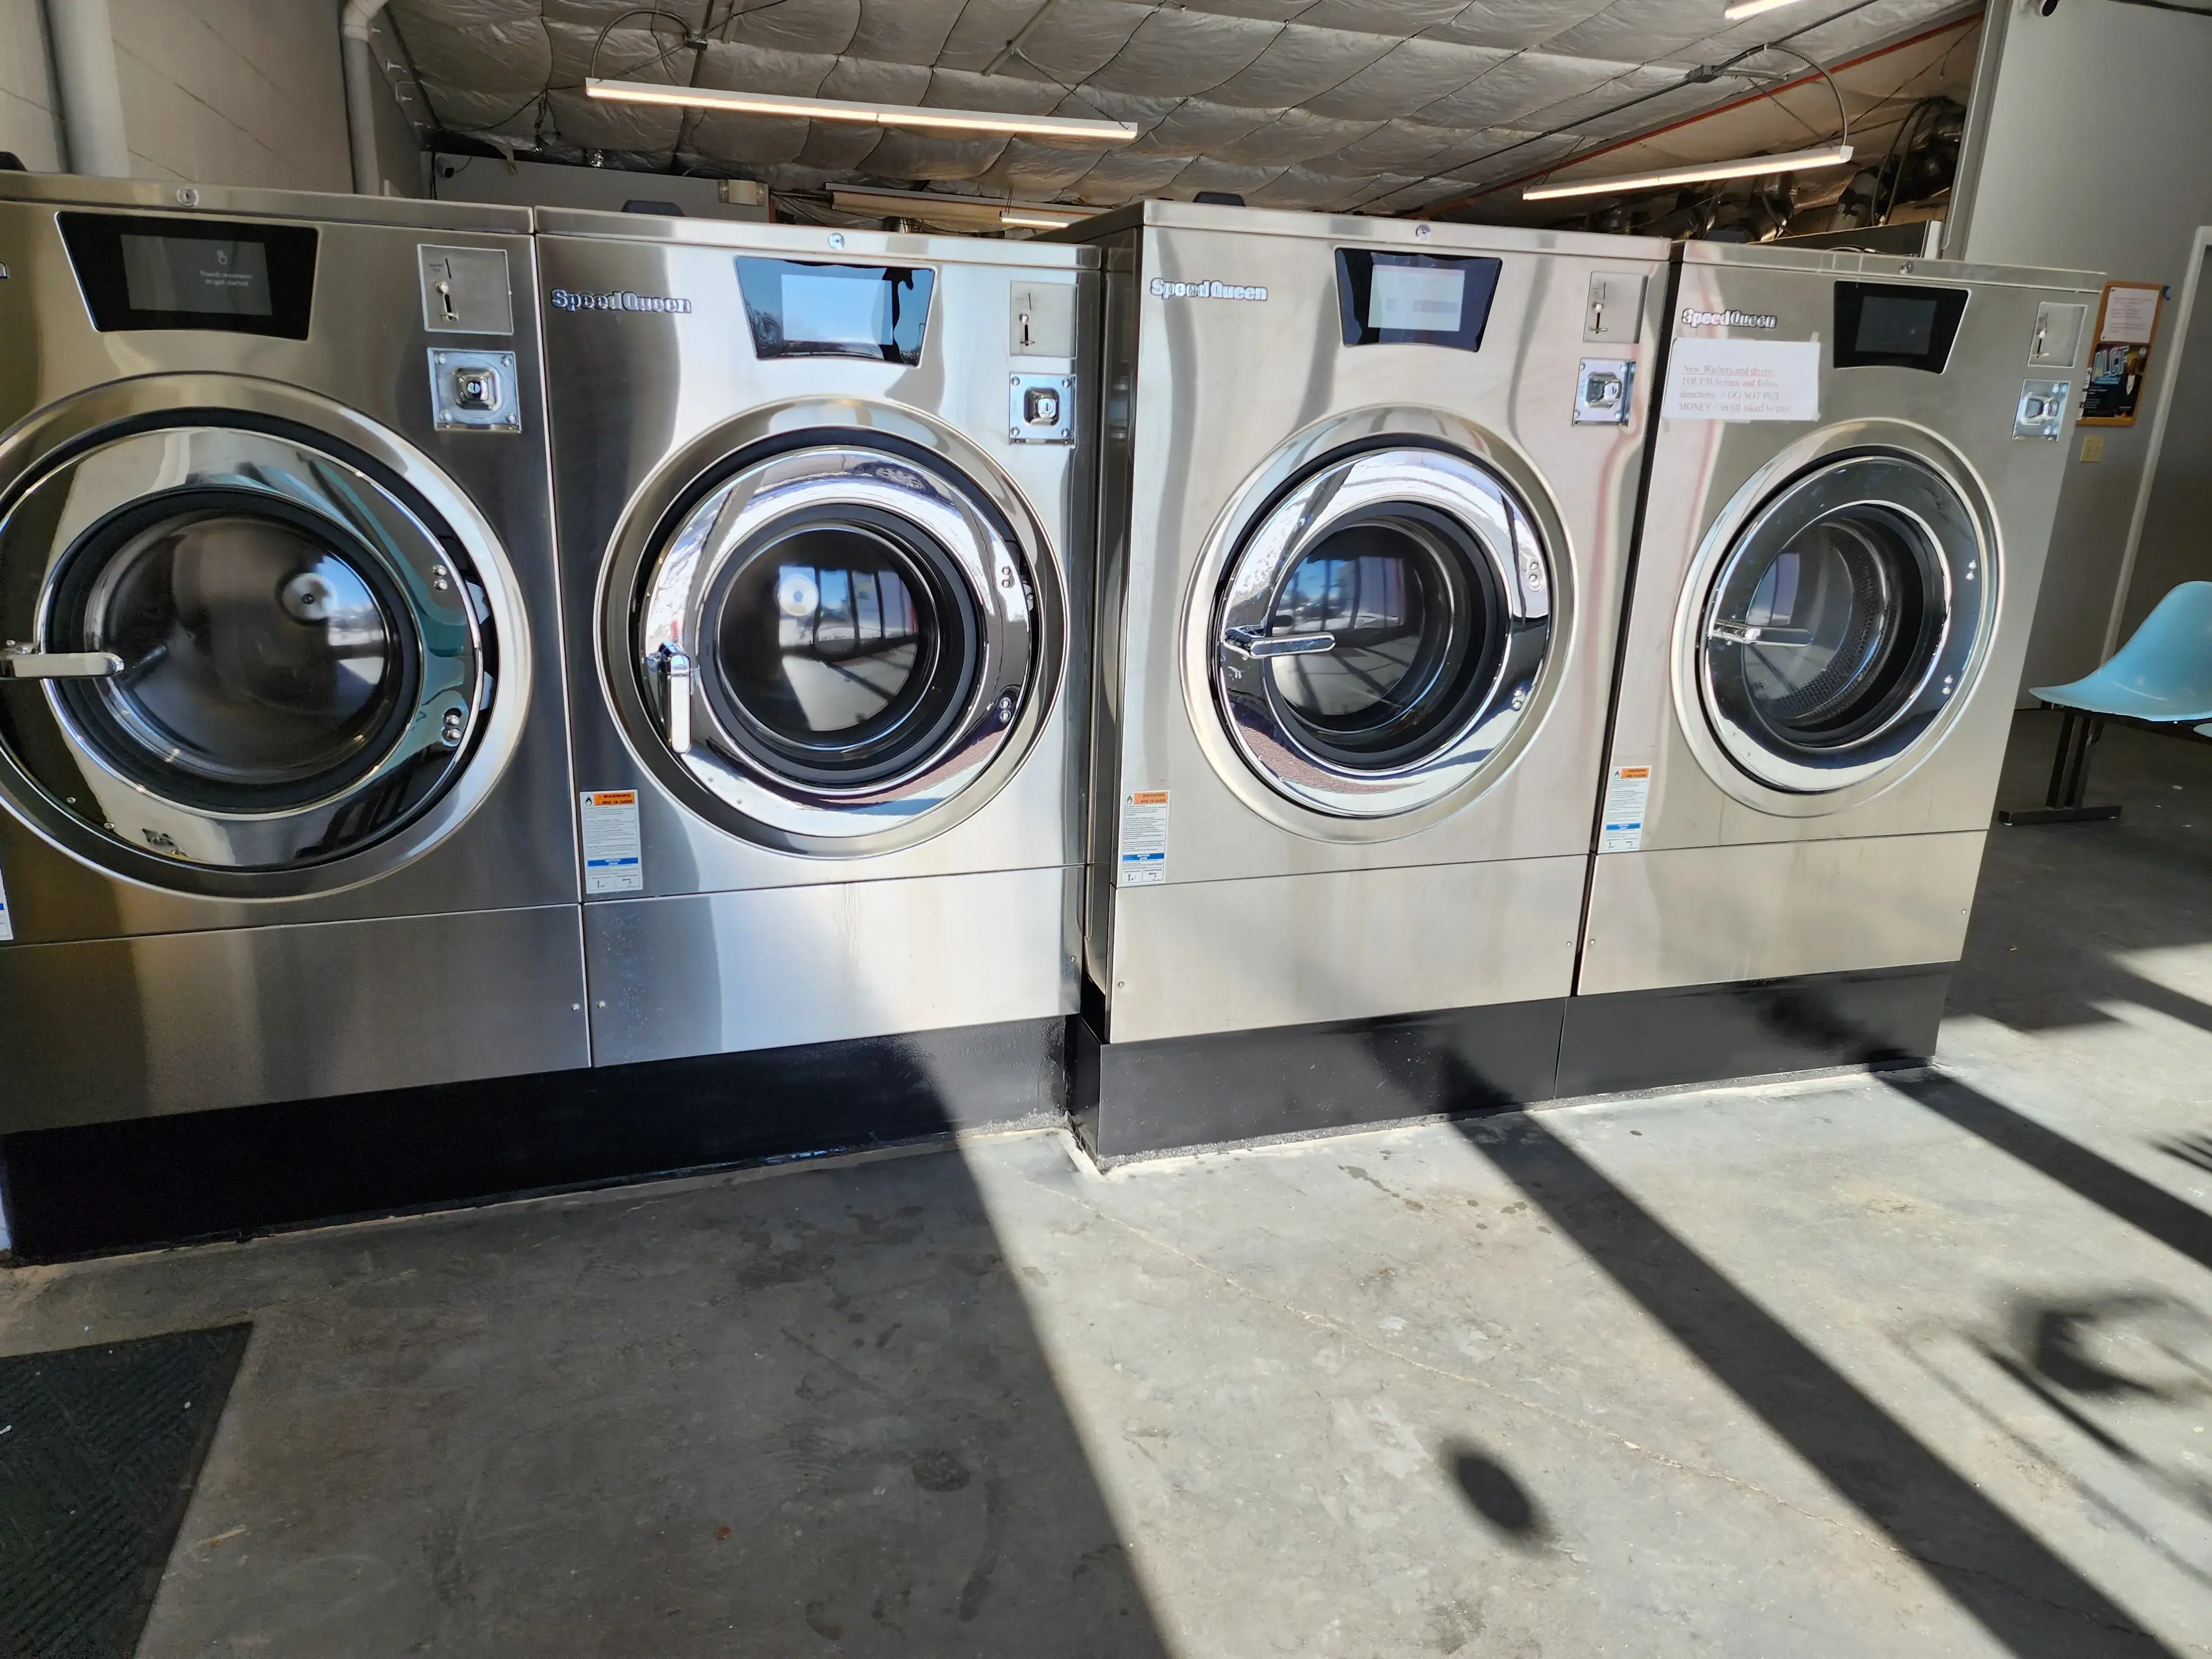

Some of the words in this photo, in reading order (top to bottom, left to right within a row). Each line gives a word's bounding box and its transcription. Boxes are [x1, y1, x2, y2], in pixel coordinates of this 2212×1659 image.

[1703, 364, 1733, 374] Washers
[1736, 366, 1748, 374] and
[1683, 377, 1713, 385] TOUCH
[1715, 378, 1740, 387] Screen
[1741, 379, 1755, 387] and
[1728, 390, 1741, 399] DO
[1744, 391, 1761, 400] NOT
[1762, 392, 1779, 400] PUT
[1679, 401, 1711, 411] MONEY
